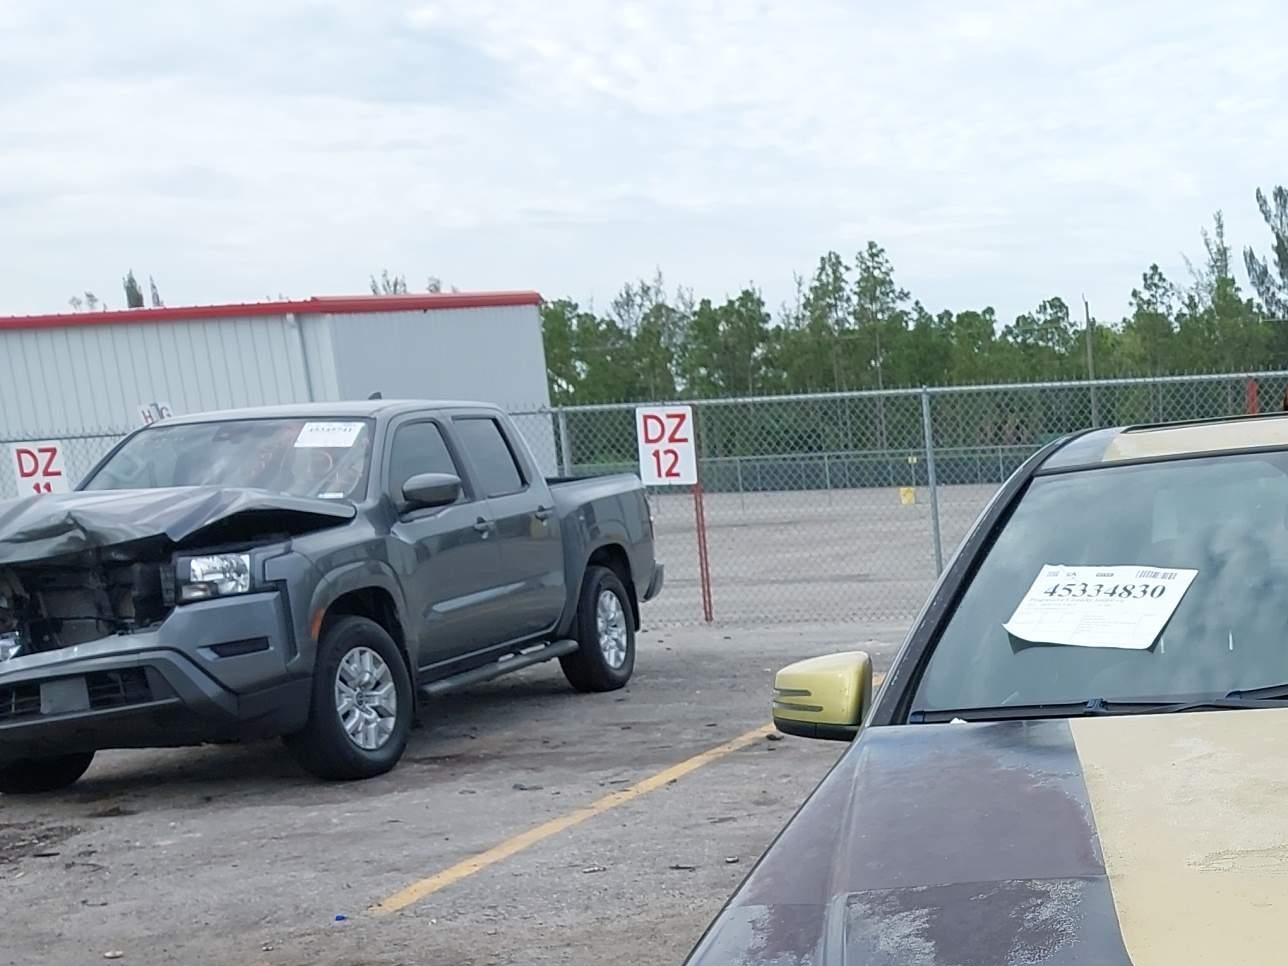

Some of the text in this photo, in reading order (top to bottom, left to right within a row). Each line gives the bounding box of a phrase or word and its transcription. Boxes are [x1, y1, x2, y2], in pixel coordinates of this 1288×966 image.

[642, 413, 689, 444] DZ
[16, 447, 62, 477] DZ
[652, 449, 680, 478] 12
[1043, 583, 1166, 599] 45334830
